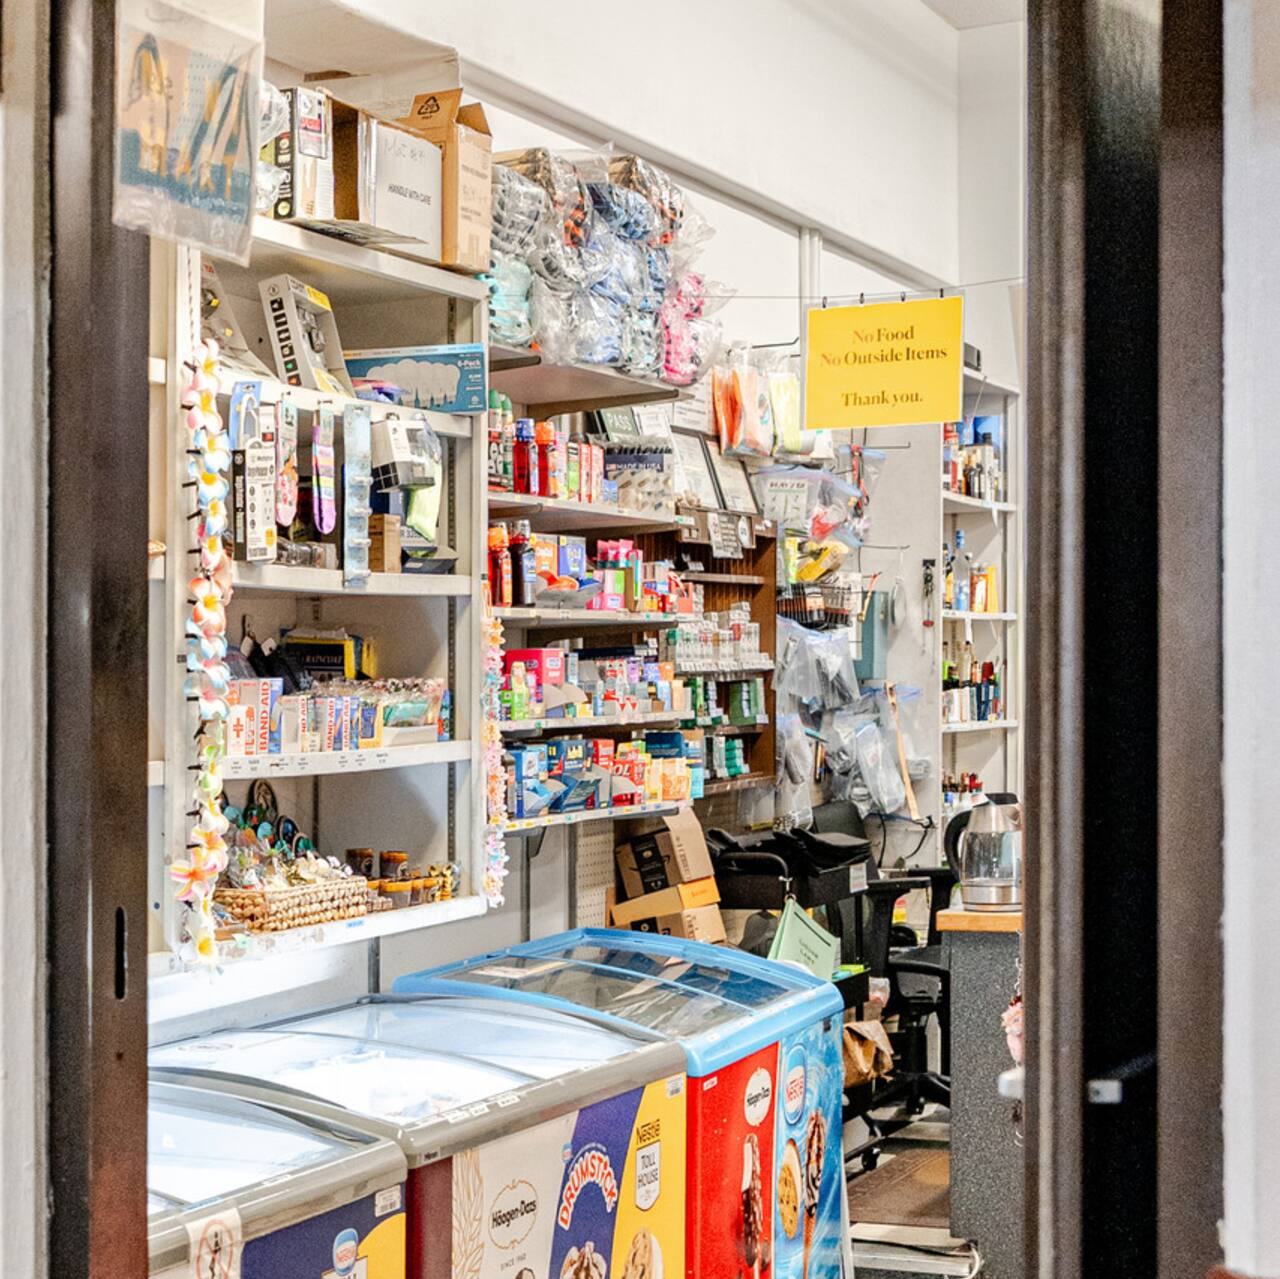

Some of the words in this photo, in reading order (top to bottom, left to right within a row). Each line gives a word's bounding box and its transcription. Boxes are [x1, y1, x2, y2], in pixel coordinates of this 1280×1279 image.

[852, 329, 875, 345] No
[876, 324, 915, 343] Food
[820, 352, 842, 368] No
[843, 347, 903, 366] Outside
[904, 346, 949, 362] Items
[840, 390, 890, 408] Thank
[891, 391, 925, 408] you.
[559, 1151, 618, 1230] DRUMSTICK
